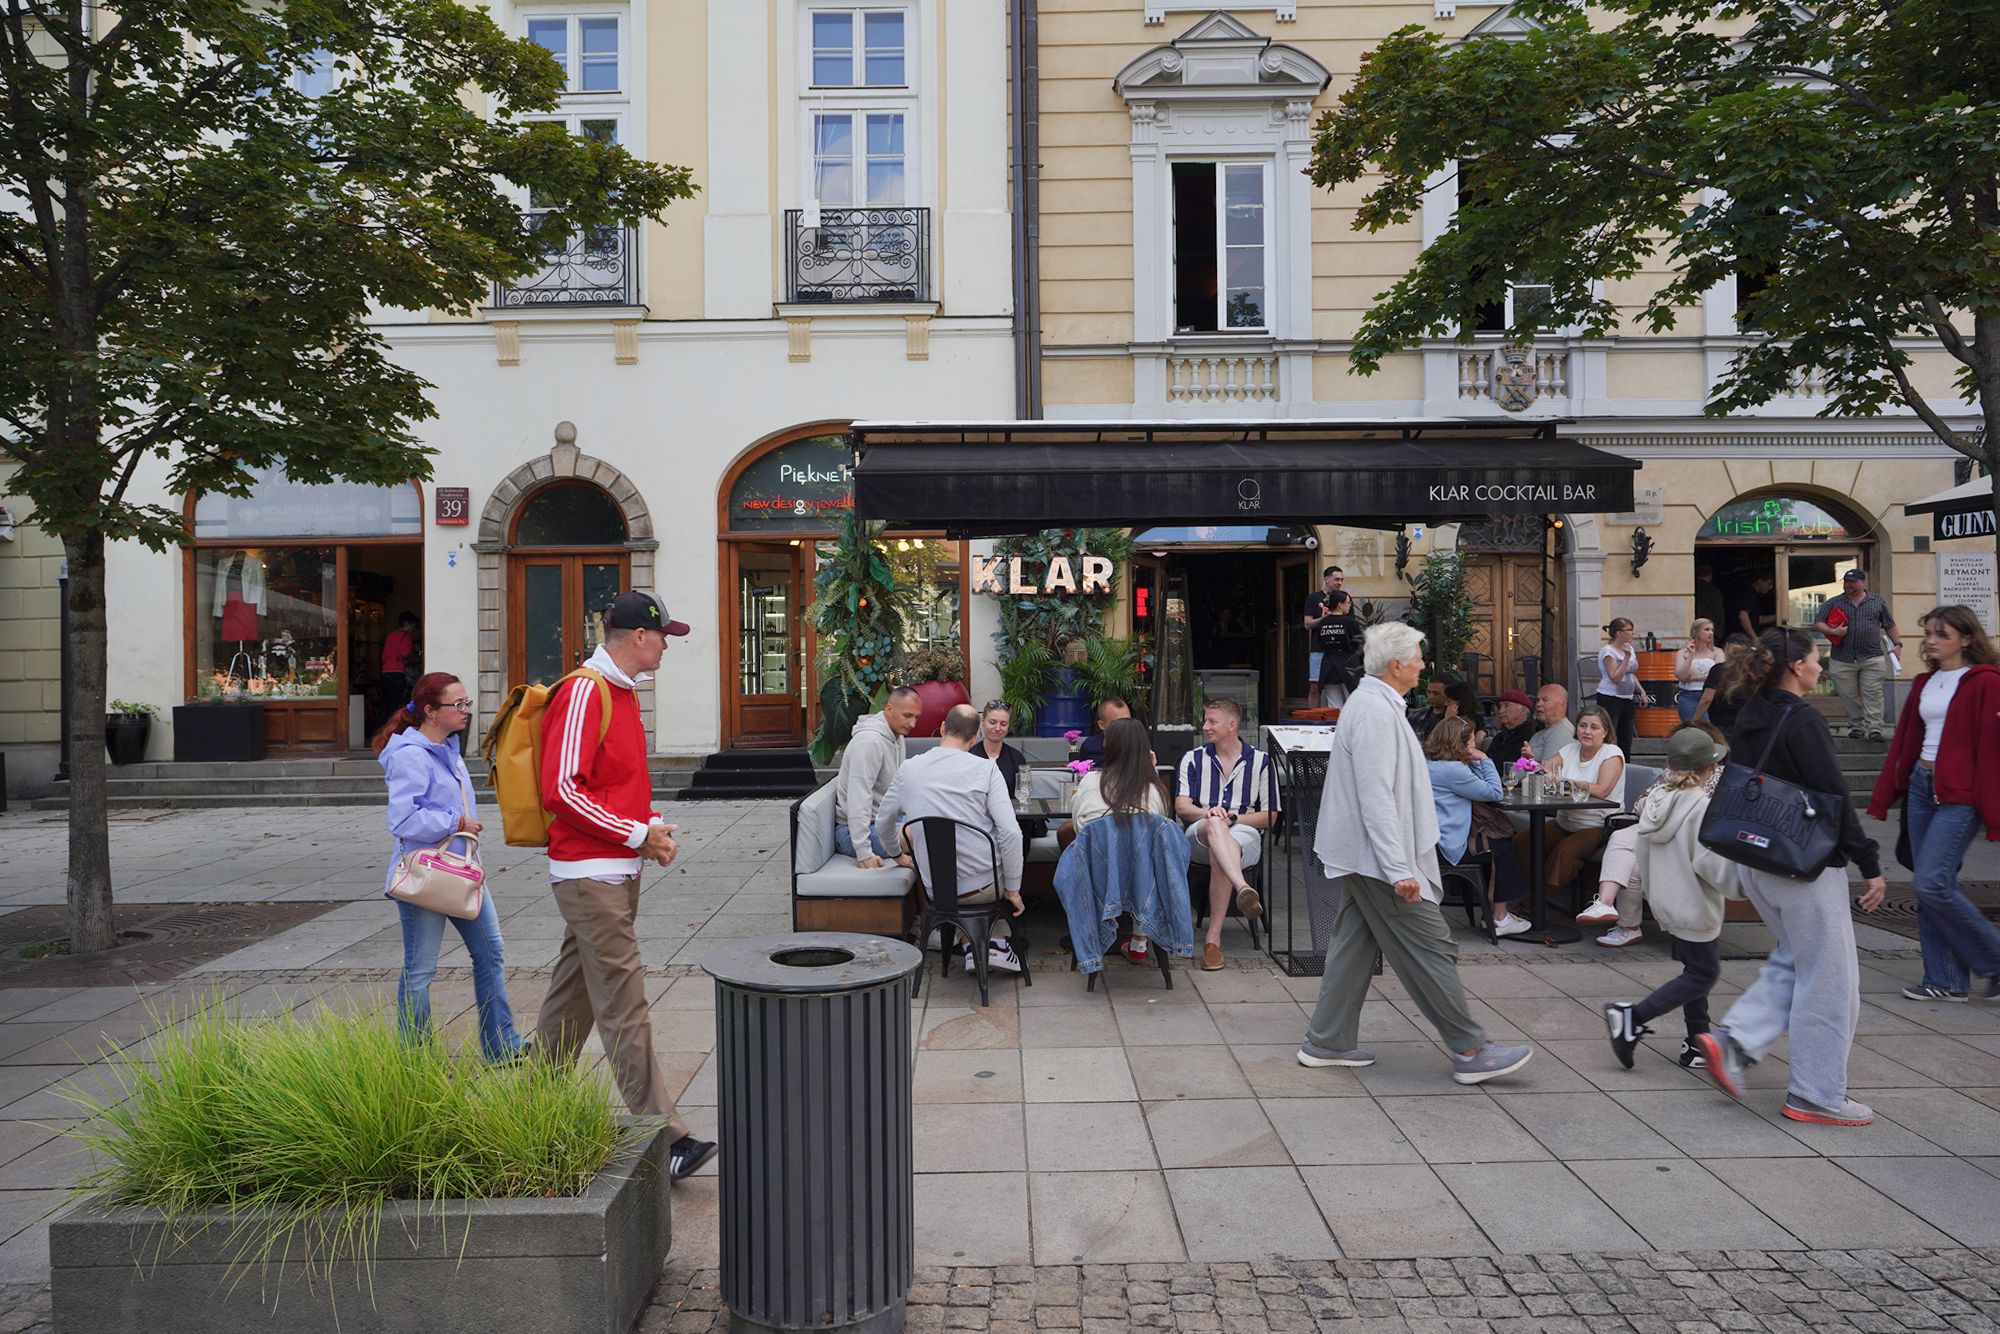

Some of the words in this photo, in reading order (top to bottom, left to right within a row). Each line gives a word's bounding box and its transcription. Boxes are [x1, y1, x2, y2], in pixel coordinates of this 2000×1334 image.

[1429, 484, 1470, 501] KLAR
[1475, 484, 1558, 501] COCKTAIL
[1563, 484, 1596, 500] BAR
[441, 499, 462, 518] 39
[1238, 500, 1261, 510] KLAR
[1716, 515, 1771, 534] Irish
[1781, 513, 1833, 534] Pub
[971, 554, 1114, 595] KLAR
[1943, 568, 1991, 576] REYMONT
